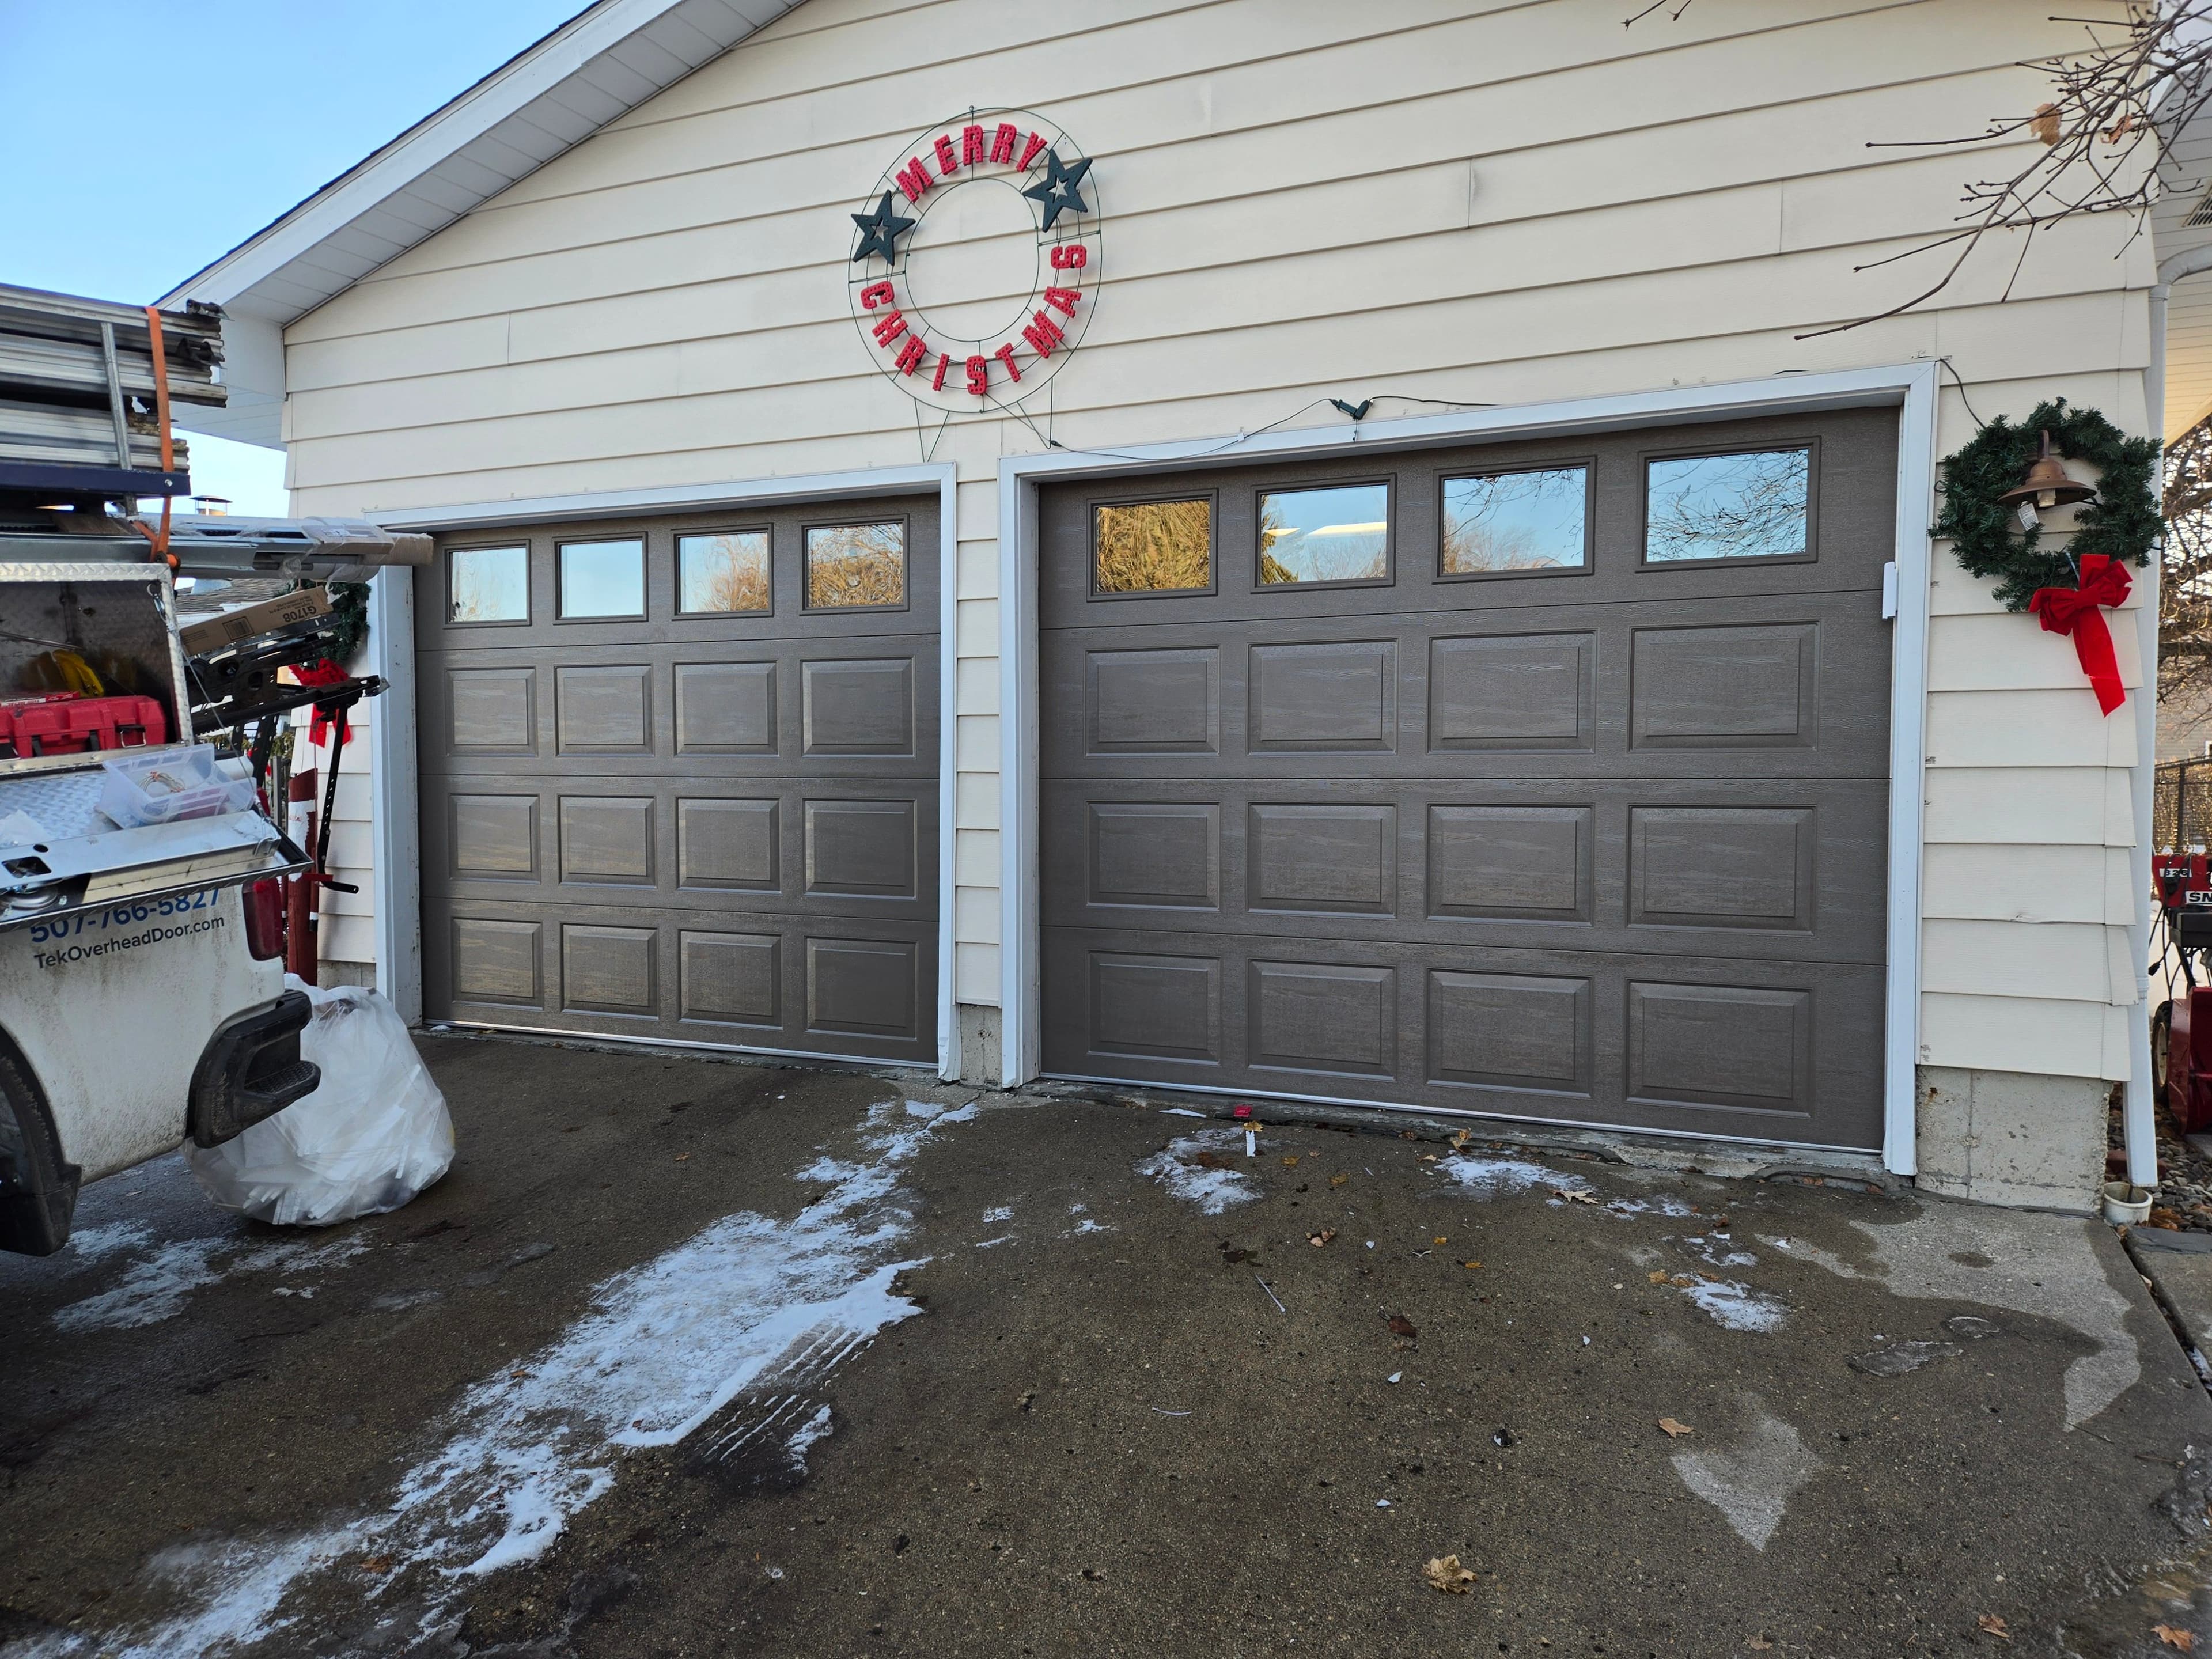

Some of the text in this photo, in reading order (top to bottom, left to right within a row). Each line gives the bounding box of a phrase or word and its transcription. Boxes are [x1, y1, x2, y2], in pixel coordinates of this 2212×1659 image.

[895, 123, 1048, 203] MERRY
[859, 244, 1087, 396] CHRISTMAS
[282, 605, 317, 623] G1708
[34, 916, 225, 969] TekOverheadDoor.com
